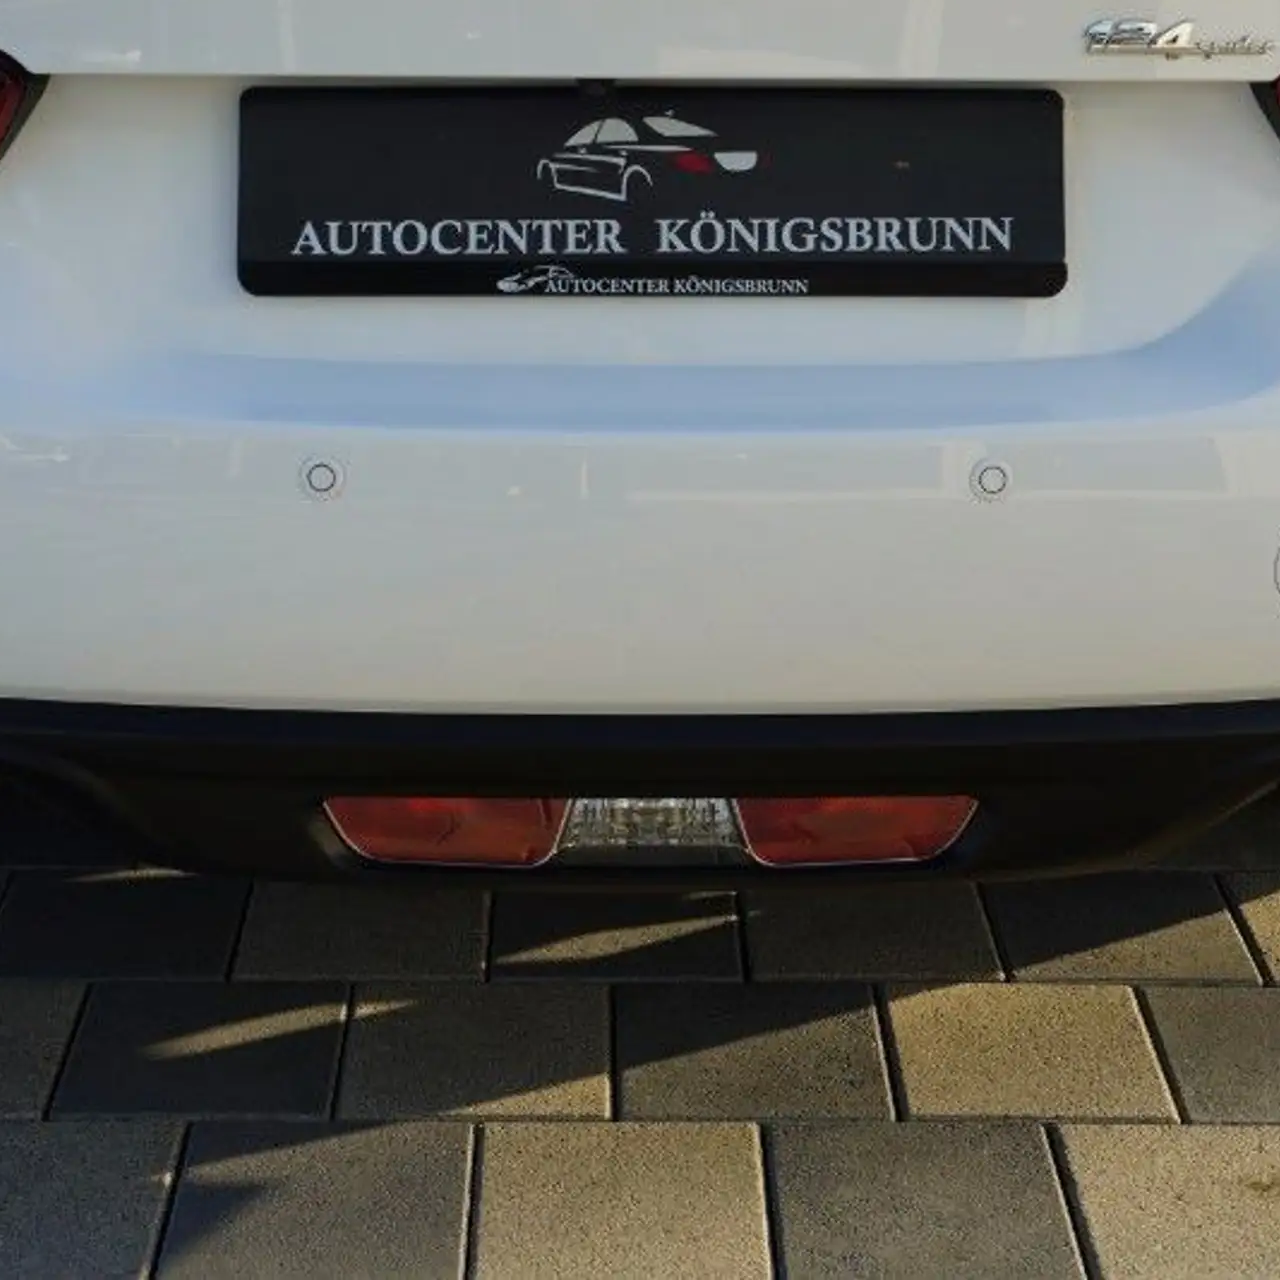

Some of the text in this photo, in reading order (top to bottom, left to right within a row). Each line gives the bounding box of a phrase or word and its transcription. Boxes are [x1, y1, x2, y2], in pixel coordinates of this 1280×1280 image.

[291, 211, 1014, 256] AUTOCENTER KÖNIGSBRUNN
[544, 275, 810, 294] AUTOCENTER KÖNIGSBRUNN
